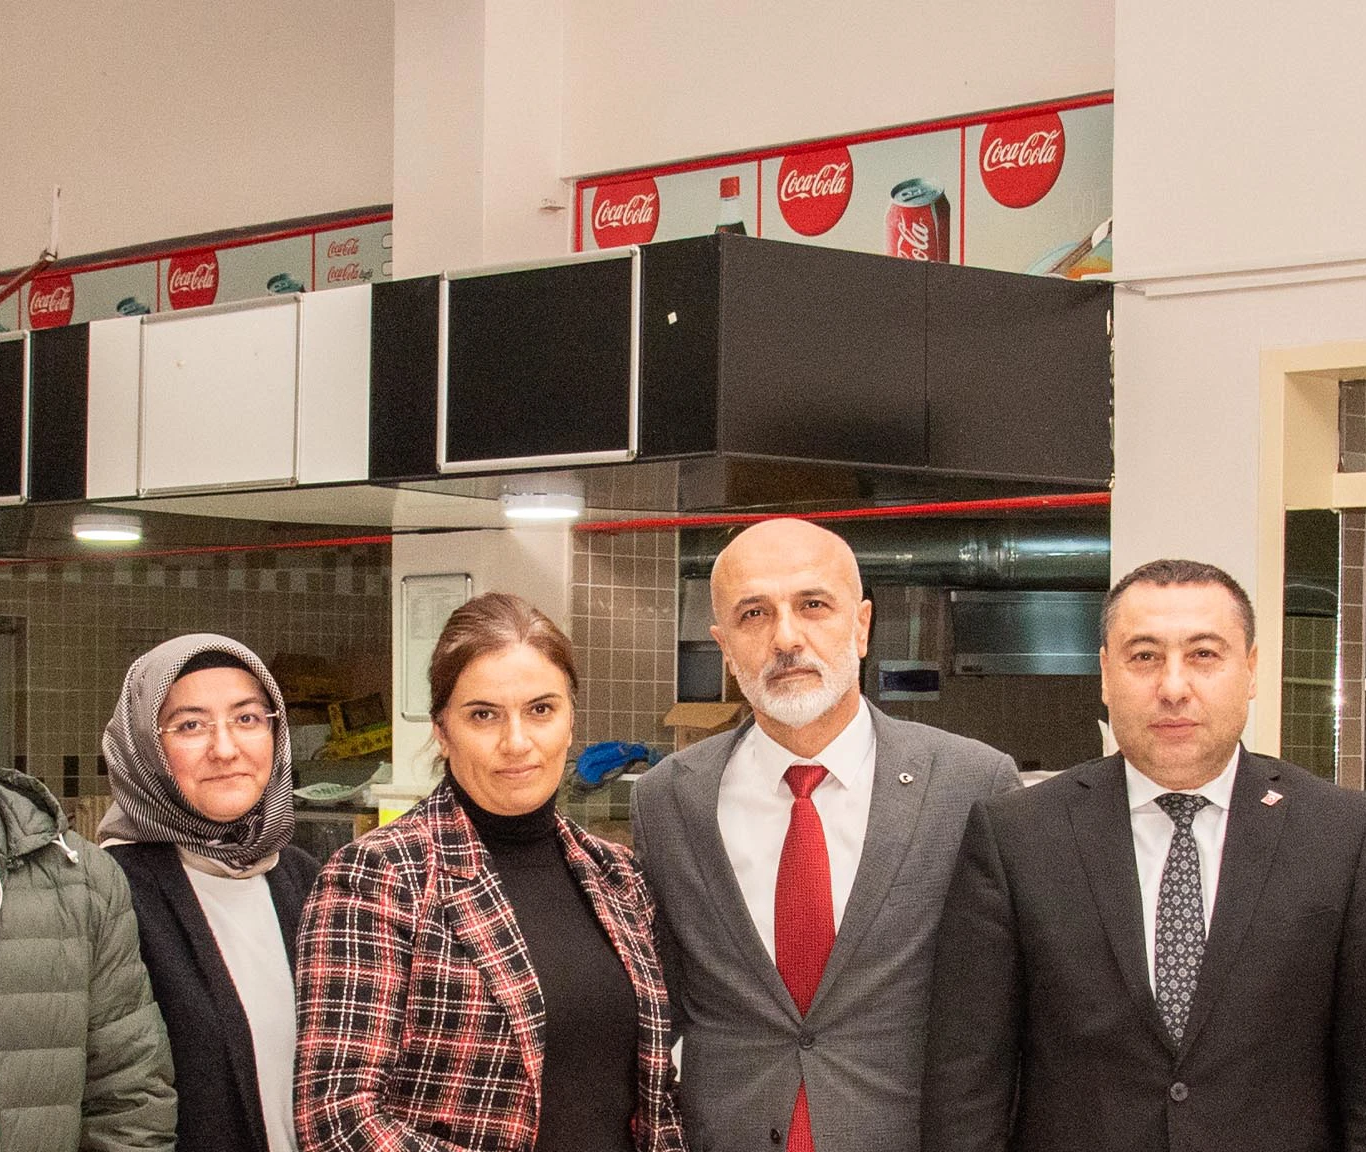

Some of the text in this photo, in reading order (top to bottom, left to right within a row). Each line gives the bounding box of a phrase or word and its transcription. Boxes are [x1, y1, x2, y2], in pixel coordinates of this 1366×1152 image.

[983, 129, 1061, 172] Coca-Cola
[781, 162, 850, 202] Coca-Cola
[595, 192, 657, 230] Coca-Cola
[170, 263, 215, 293] Coca-Cola
